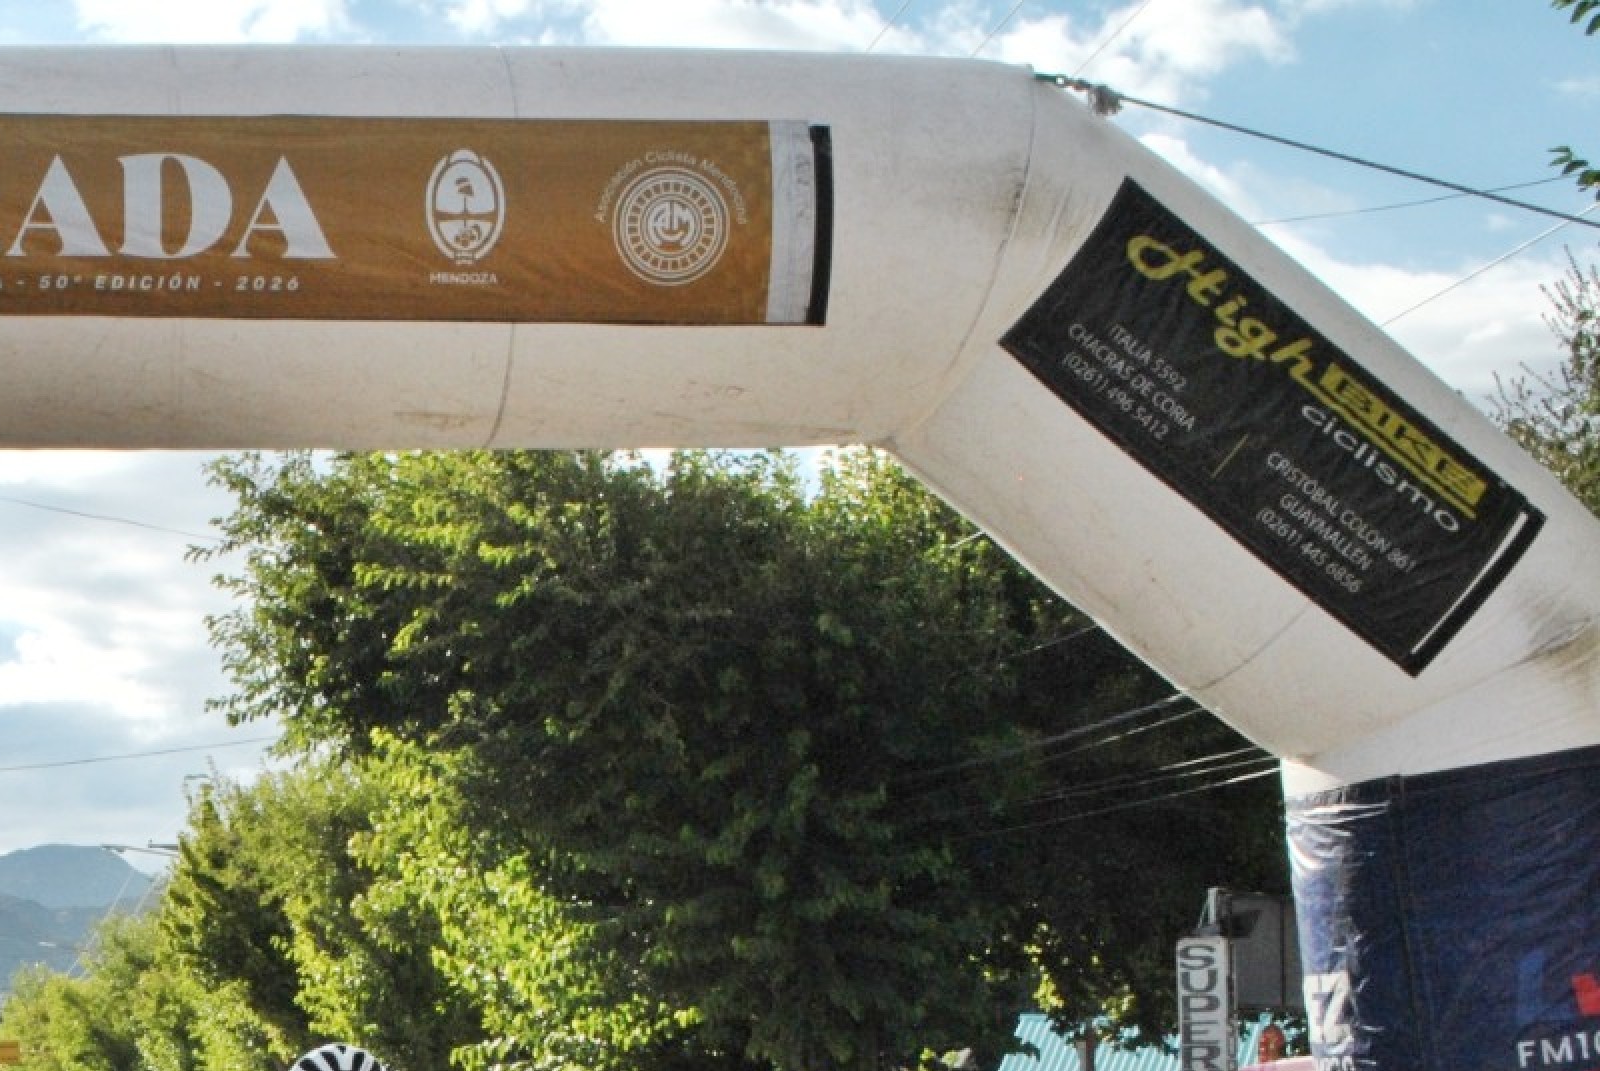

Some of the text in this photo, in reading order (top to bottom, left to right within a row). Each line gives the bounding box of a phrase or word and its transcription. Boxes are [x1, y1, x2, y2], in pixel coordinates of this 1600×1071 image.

[94, 271, 201, 291] EDICIÓN
[236, 274, 299, 291] 2026
[430, 271, 498, 285] MENDOZA
[1067, 322, 1198, 432] CHACRAS DE CORIA
[1108, 325, 1189, 393] ITALIA 5592
[1132, 406, 1169, 440] 5412
[1301, 404, 1461, 533] ciclismo
[1279, 492, 1373, 573] GUAYMALLEN
